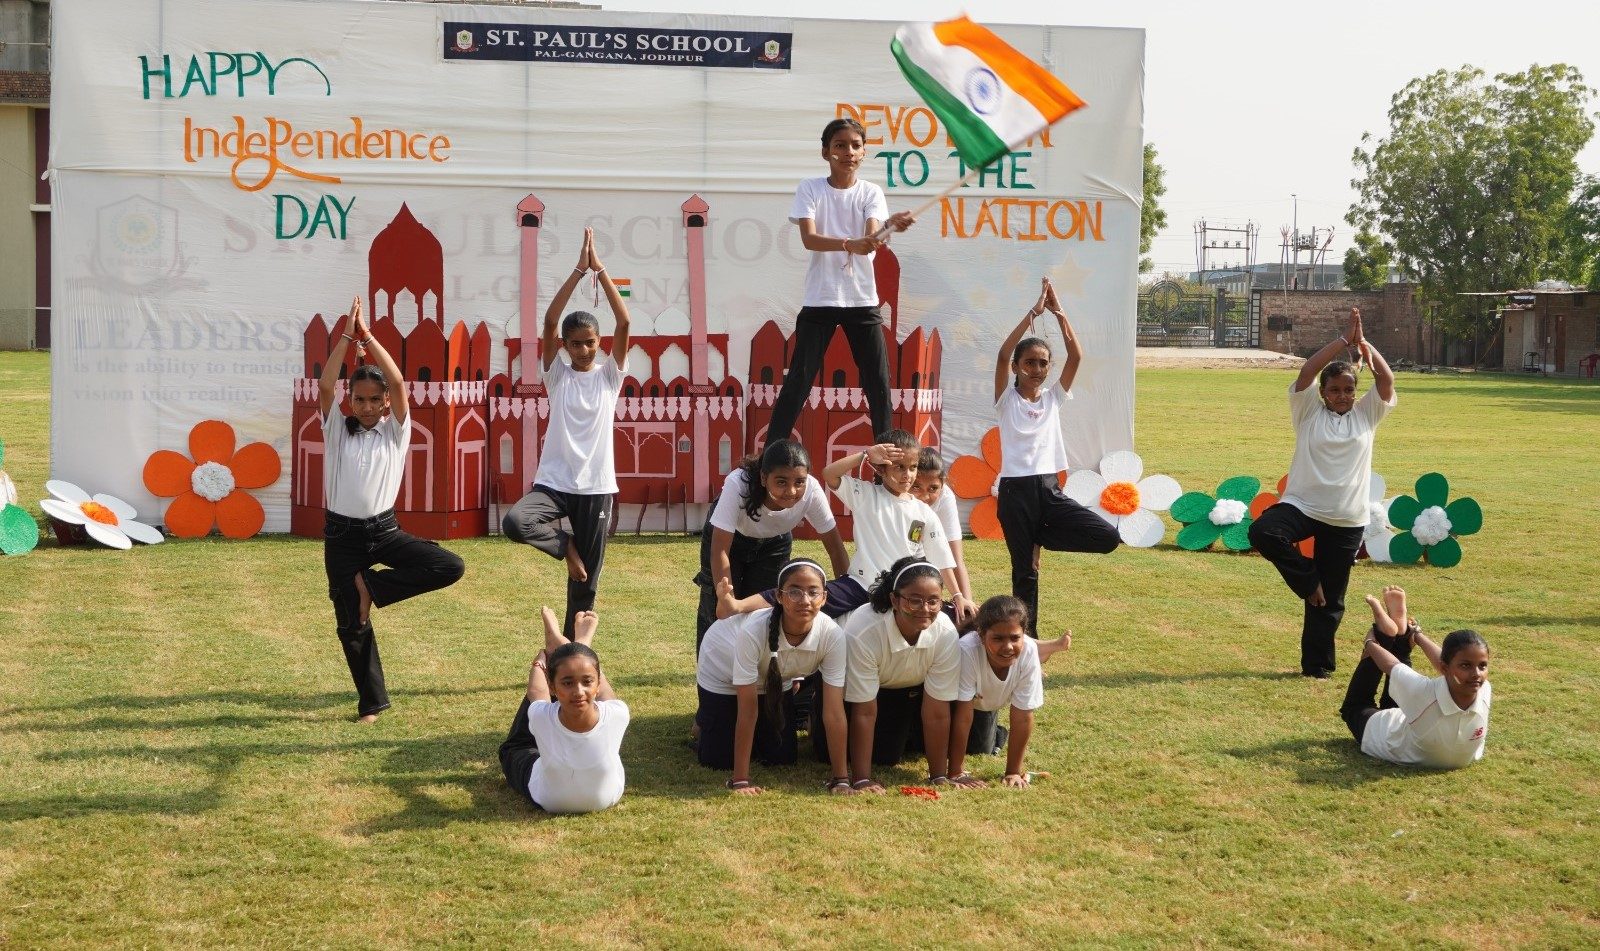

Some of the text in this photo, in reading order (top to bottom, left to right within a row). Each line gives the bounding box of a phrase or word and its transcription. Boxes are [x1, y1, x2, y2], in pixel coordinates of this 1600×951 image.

[486, 29, 751, 54] ST. PAUL'S SCHOOL
[639, 53, 704, 63] JODHPUR
[138, 51, 331, 100] HAPPY
[874, 150, 1036, 190] TO THE
[272, 194, 356, 241] DAY
[939, 197, 1106, 242] NATION
[97, 357, 128, 374] the
[135, 357, 200, 379] ability
[207, 360, 226, 374] to
[73, 384, 134, 401] vision
